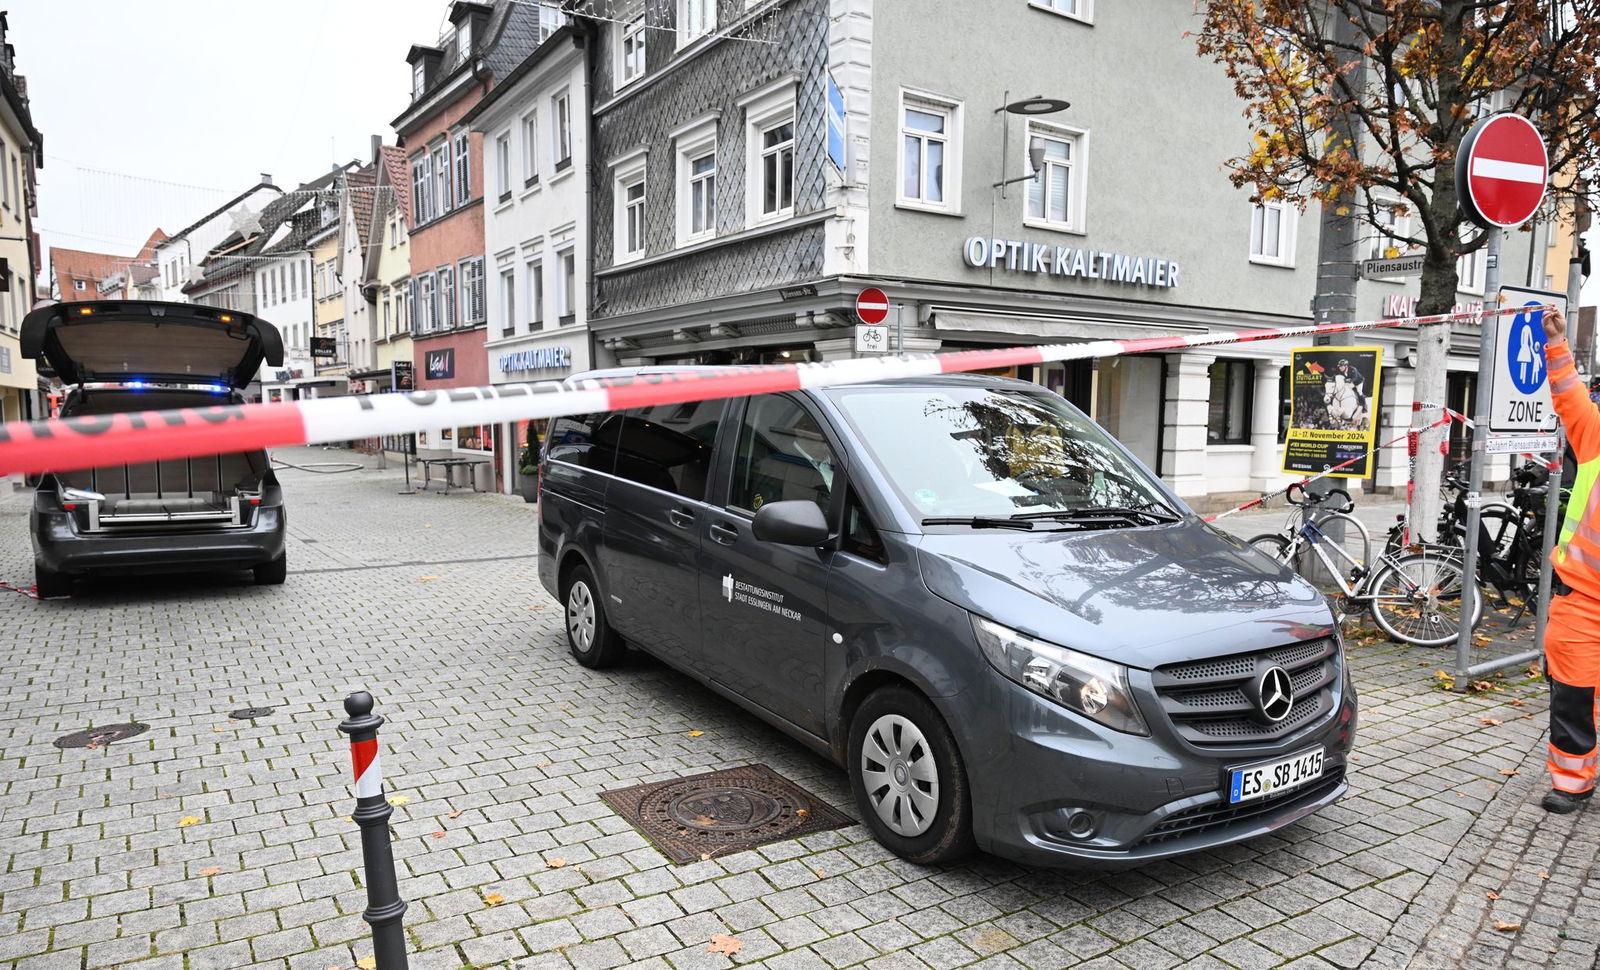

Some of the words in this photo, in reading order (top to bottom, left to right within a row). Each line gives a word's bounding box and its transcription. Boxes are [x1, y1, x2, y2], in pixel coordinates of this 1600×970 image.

[964, 236, 1047, 273] OPTIK
[1050, 246, 1180, 288] KALTMAIER
[1367, 261, 1424, 274] Pliensaustr
[866, 341, 878, 350] frei
[498, 352, 519, 373] OPTIK
[520, 346, 571, 370] KALTMAIER
[1508, 400, 1543, 423] ZONE
[1310, 432, 1345, 440] November
[735, 580, 784, 603] BESTATTUNGSINSTITUT
[734, 591, 748, 603] STADT
[748, 596, 772, 611] ESSLINGEN
[772, 604, 781, 615] AM
[781, 607, 802, 621] NECKAR
[1242, 769, 1263, 796] ES
[1272, 763, 1290, 788] SB
[1293, 752, 1322, 783] 1415
